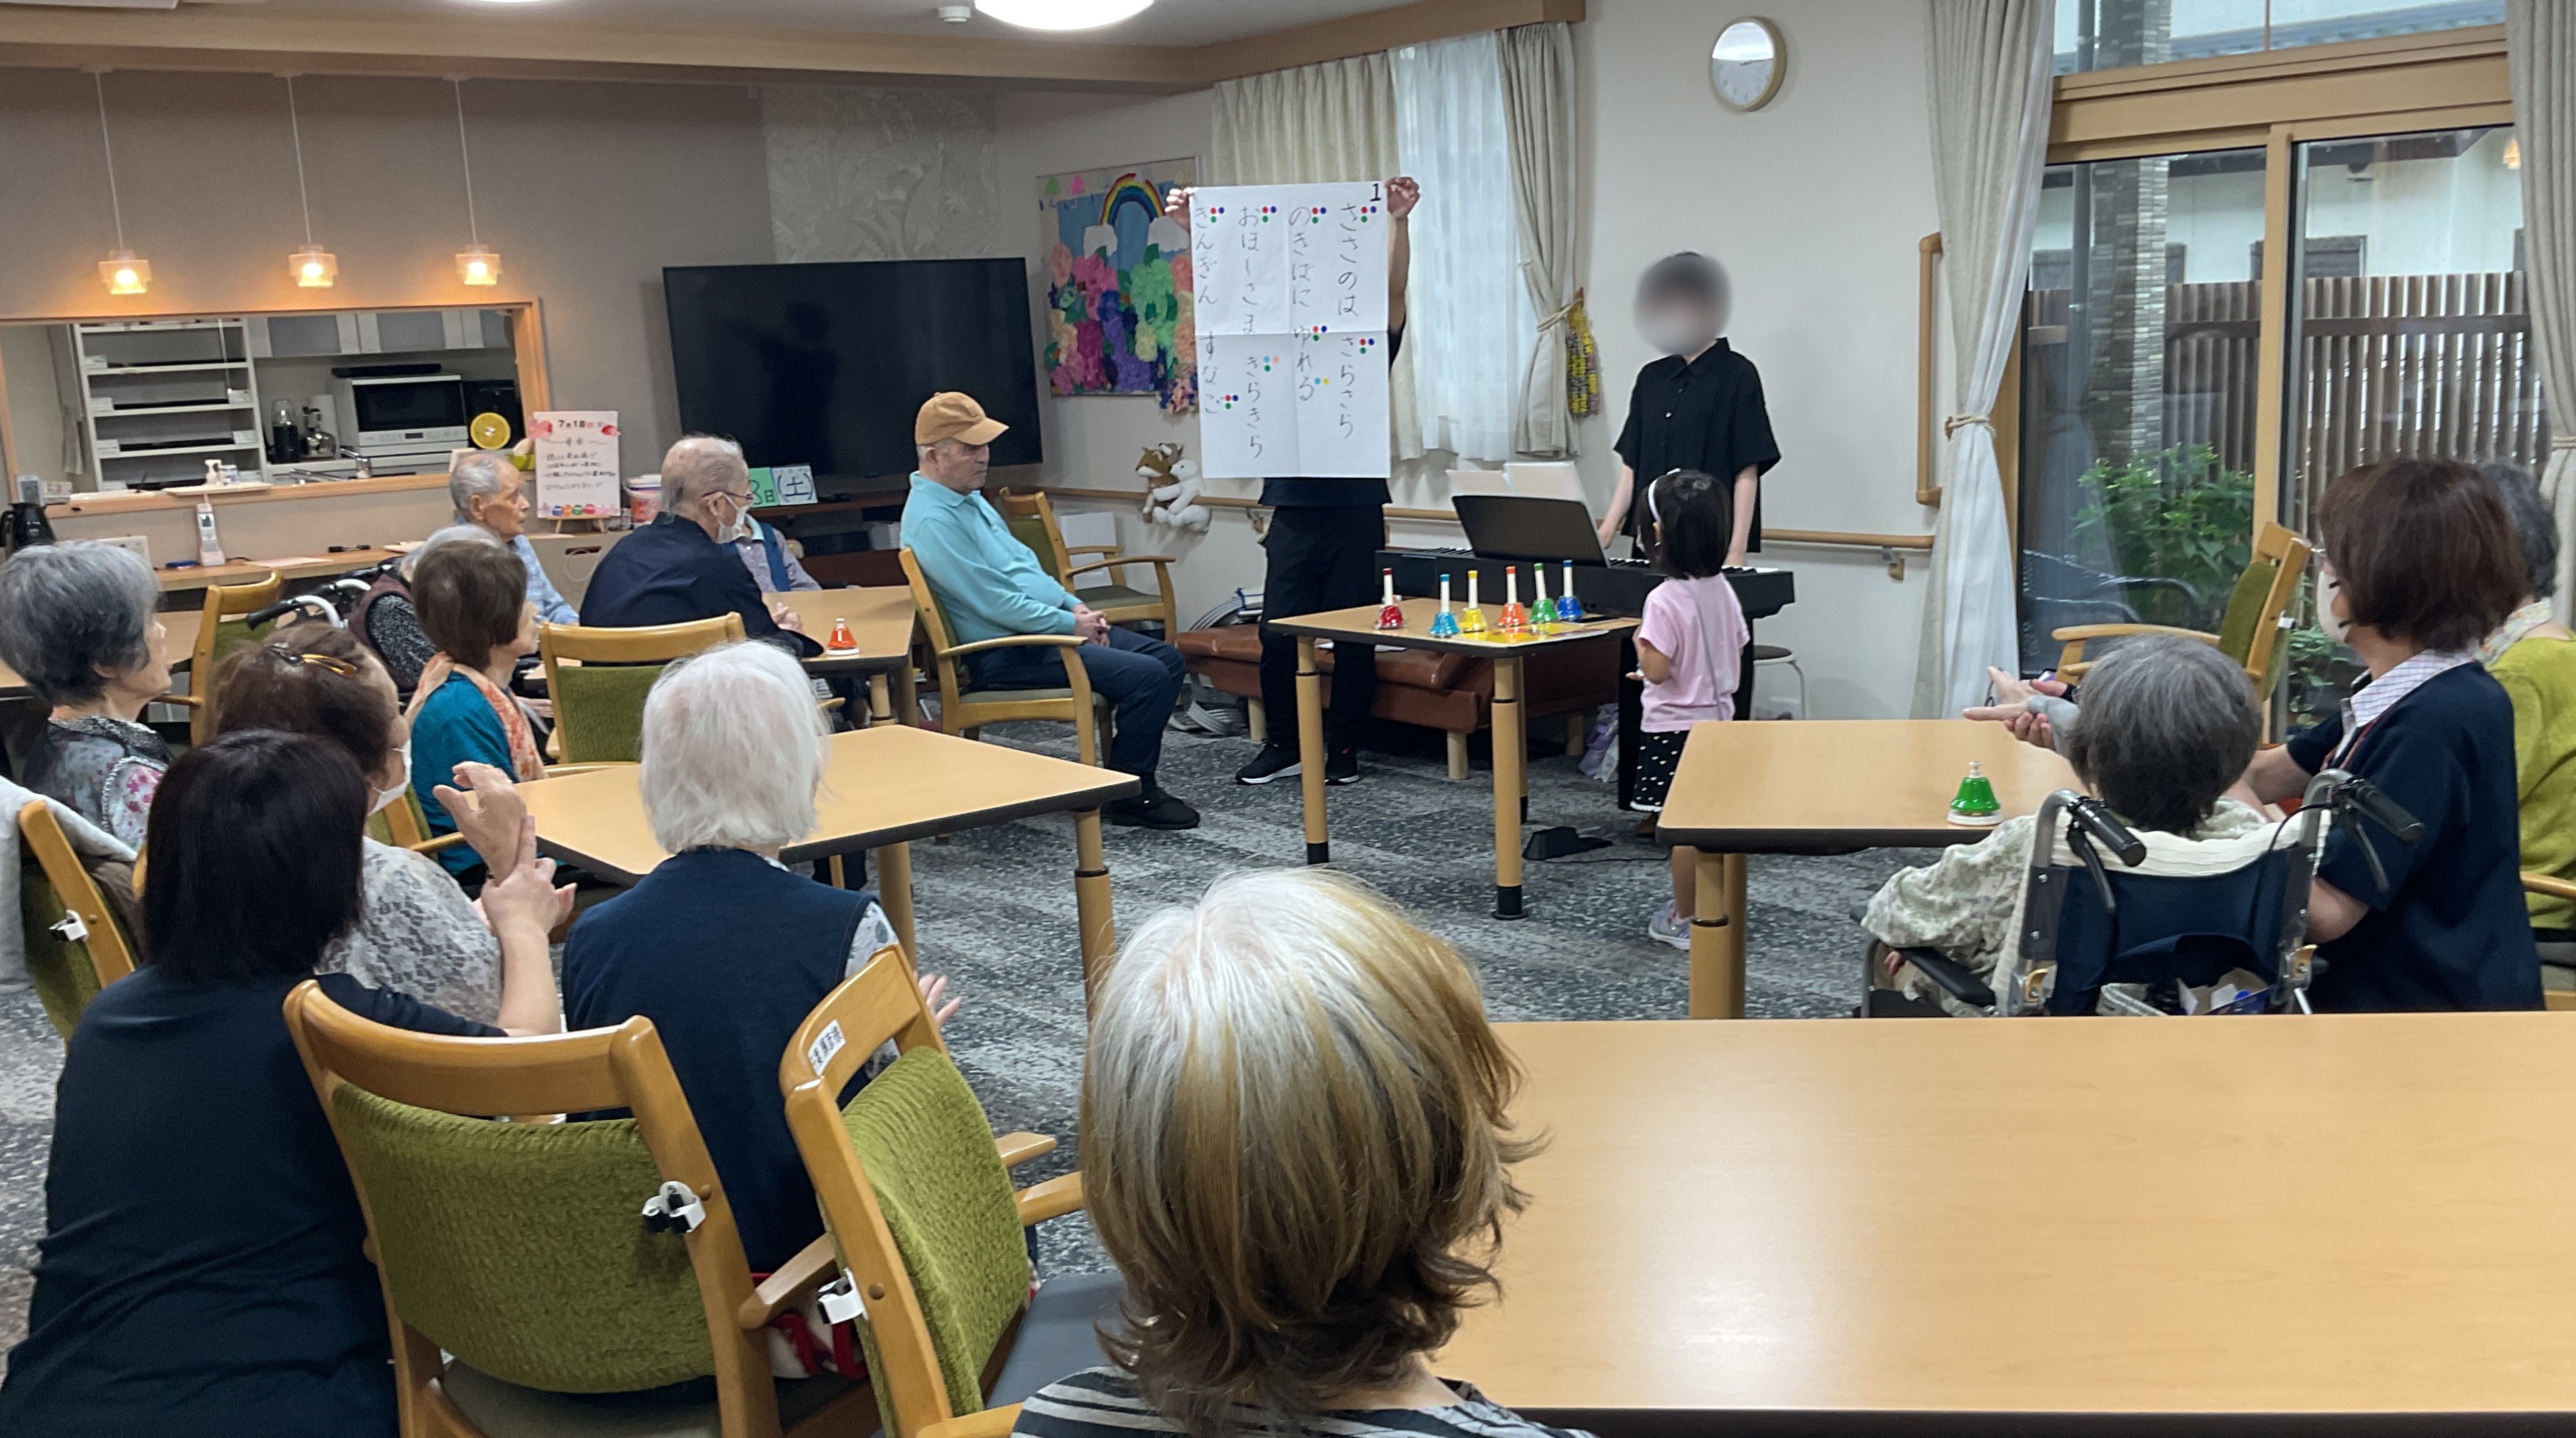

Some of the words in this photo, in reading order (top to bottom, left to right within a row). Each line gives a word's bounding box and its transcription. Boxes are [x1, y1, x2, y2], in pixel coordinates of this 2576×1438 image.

[1370, 183, 1381, 202] 1
[1195, 207, 1219, 305] きんぎん
[1239, 207, 1260, 333] おほしさま
[1338, 202, 1359, 317] ささのは
[1200, 331, 1224, 414] すなご
[1246, 357, 1263, 459] きらきら
[1293, 326, 1315, 401] ゆれる
[1340, 337, 1355, 439] さらさら
